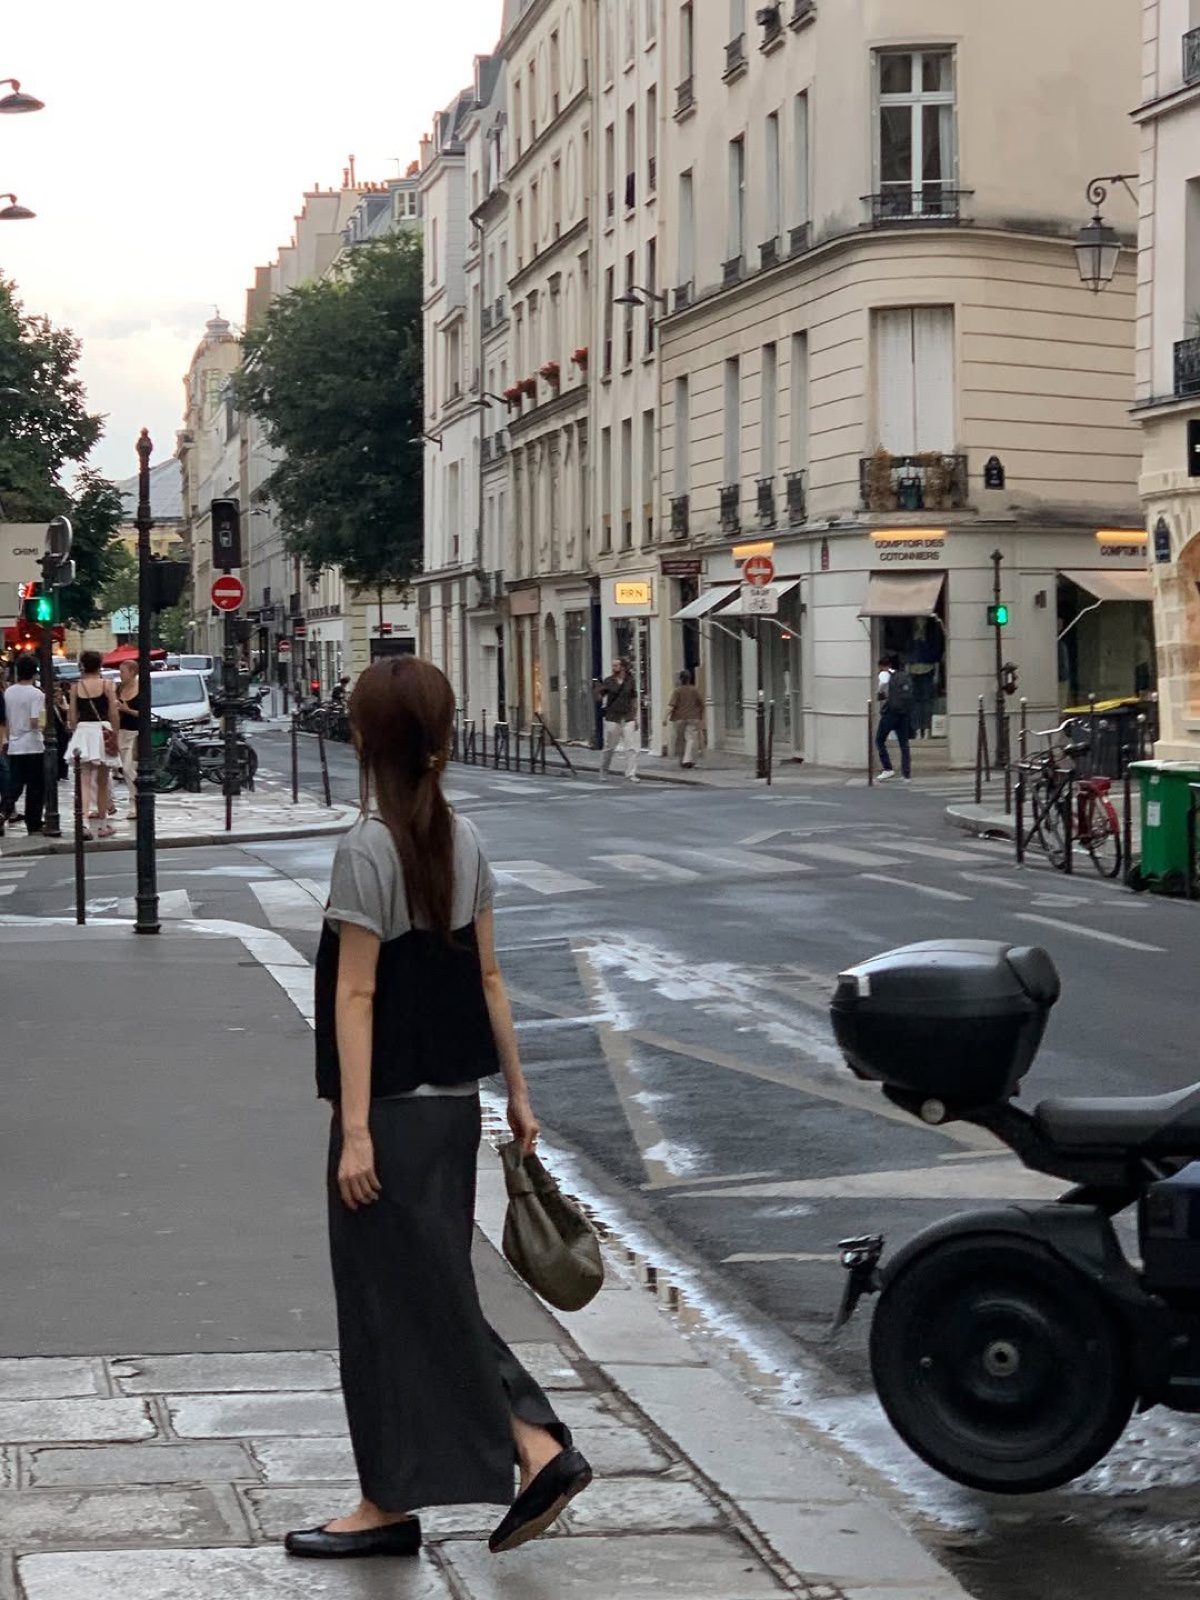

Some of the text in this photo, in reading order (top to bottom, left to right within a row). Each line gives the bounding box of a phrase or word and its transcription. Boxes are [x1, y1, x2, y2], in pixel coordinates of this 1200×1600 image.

[875, 539, 945, 549] COMPTOIR DES
[879, 551, 940, 561] COTONNIERS
